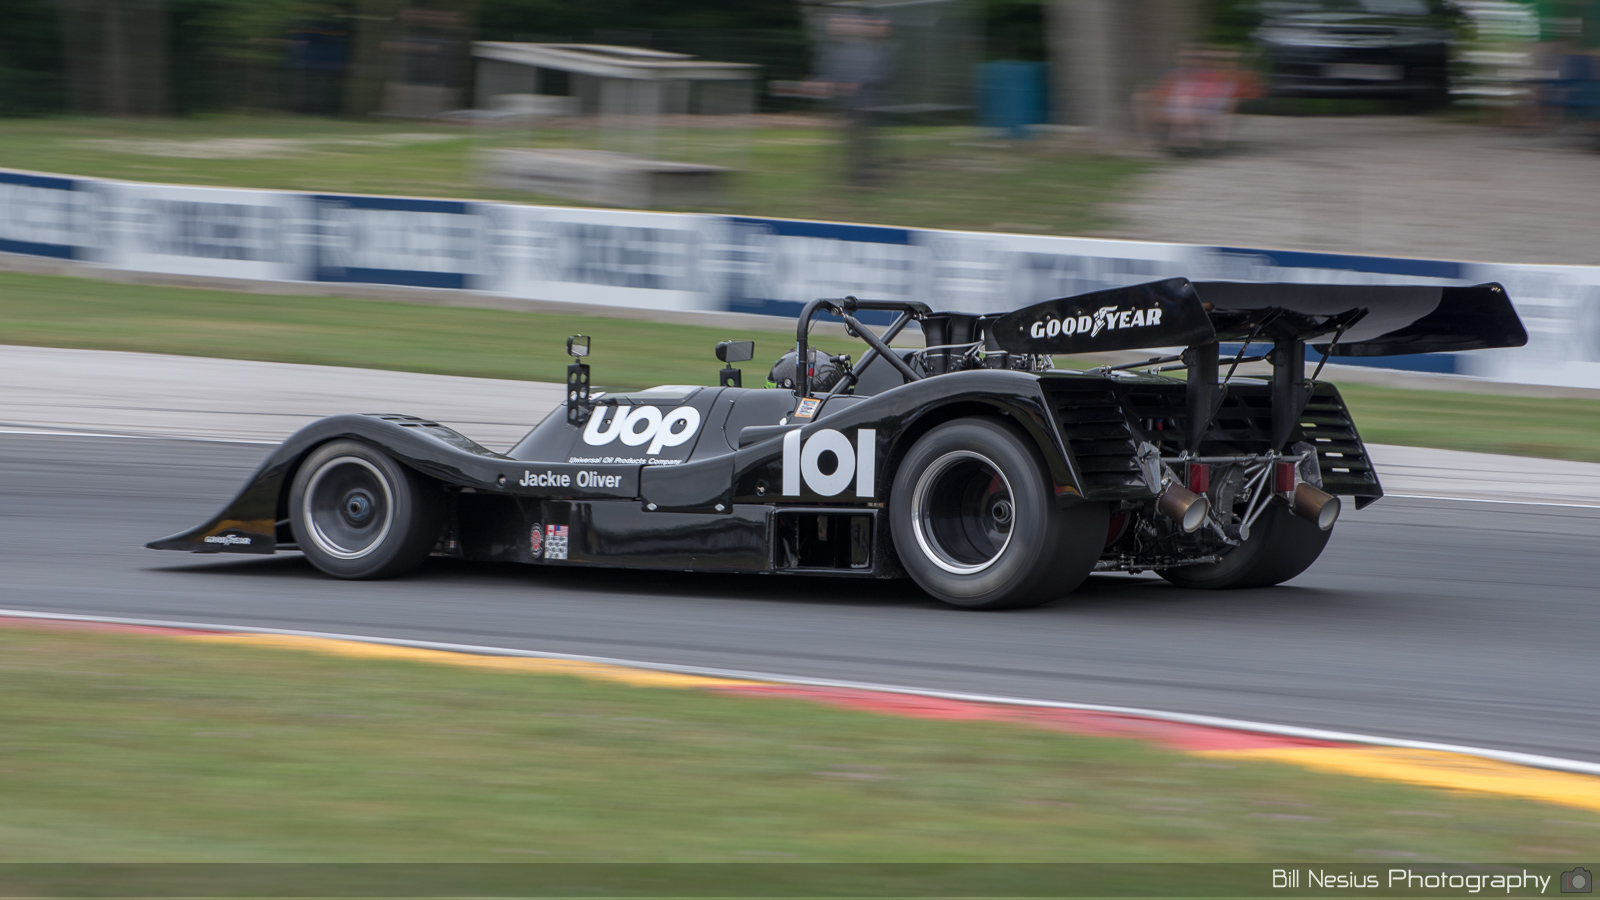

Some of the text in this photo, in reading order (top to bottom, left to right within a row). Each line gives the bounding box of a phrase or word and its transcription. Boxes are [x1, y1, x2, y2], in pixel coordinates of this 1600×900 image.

[1030, 305, 1163, 338] GOODYEAR
[568, 456, 683, 466] Universal Oil Products Company
[782, 428, 876, 497] 101
[519, 470, 622, 488] Jackie Oliver
